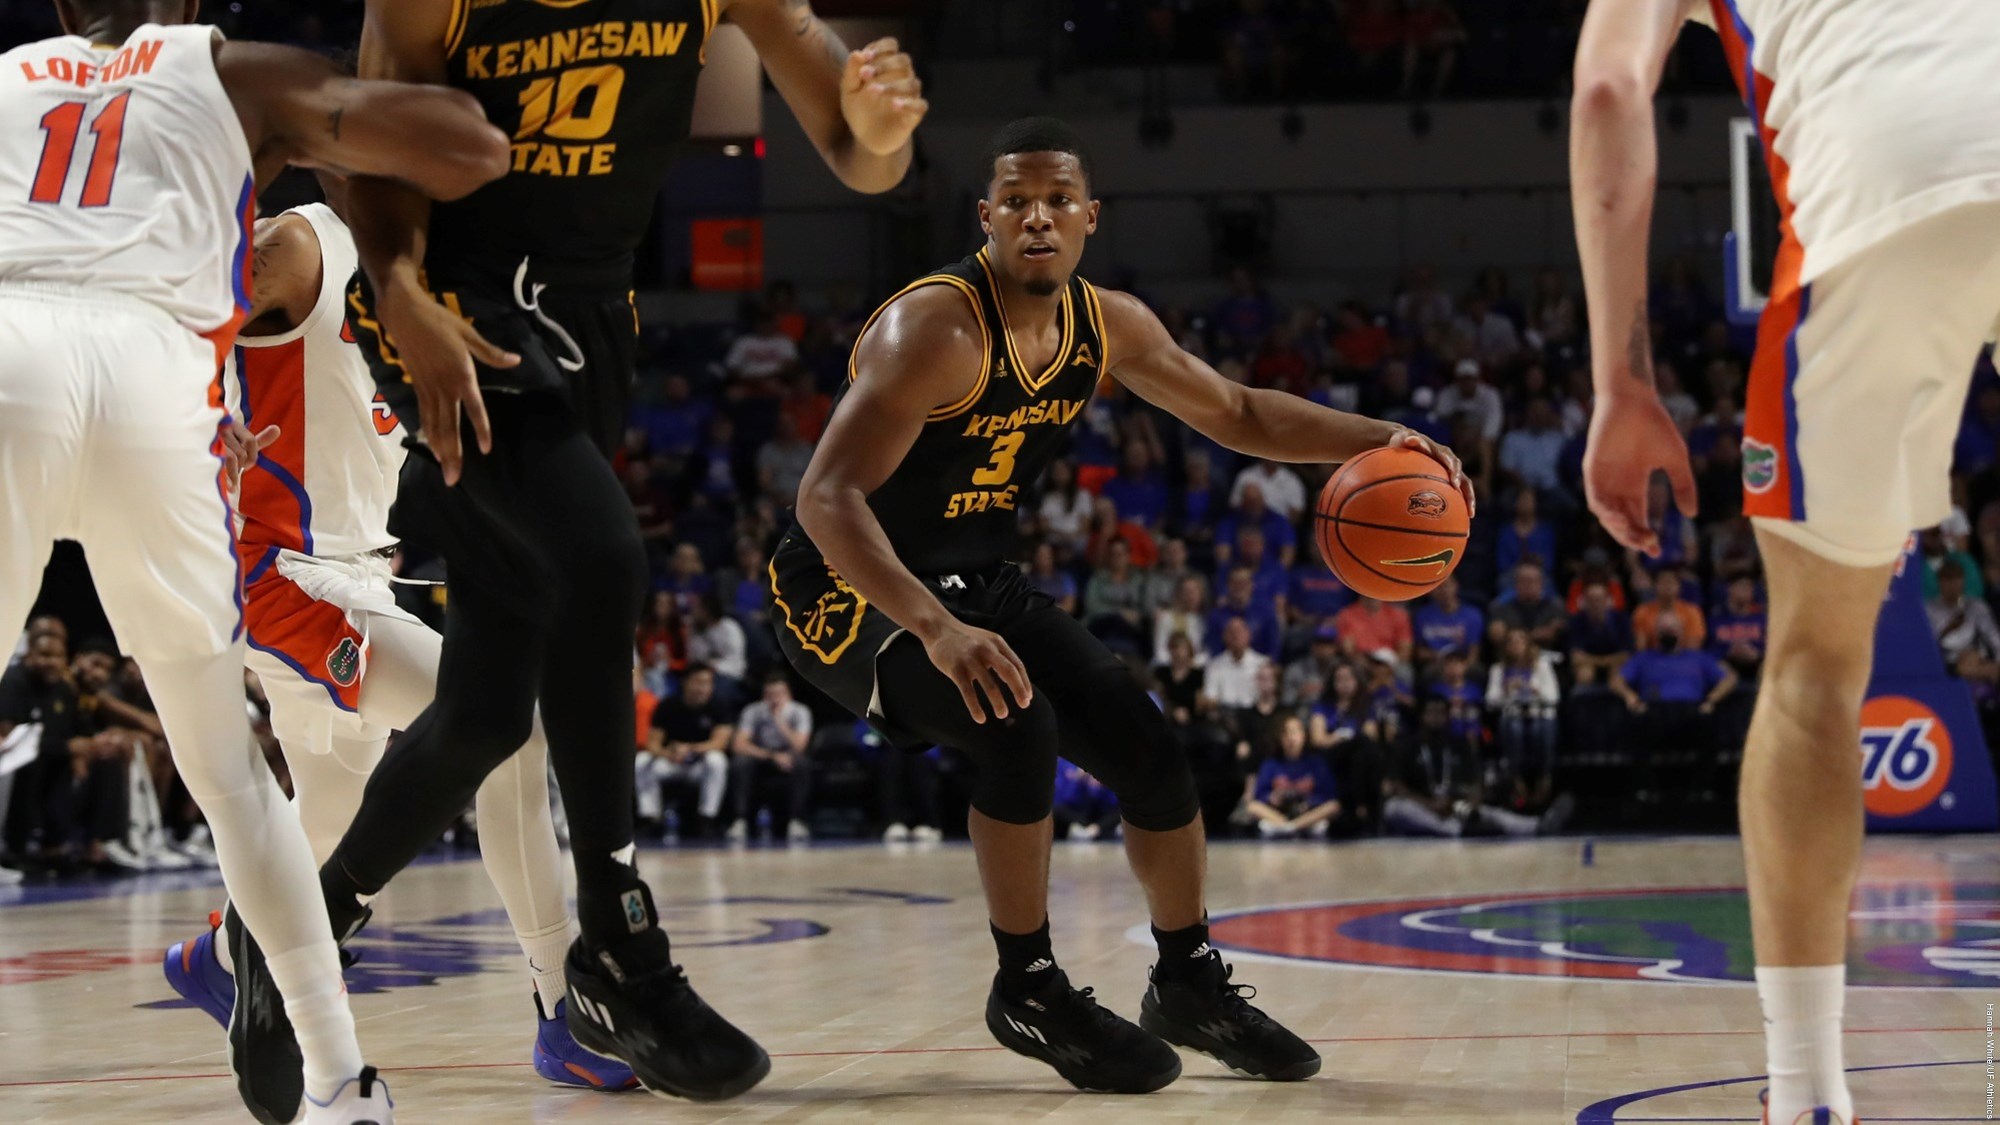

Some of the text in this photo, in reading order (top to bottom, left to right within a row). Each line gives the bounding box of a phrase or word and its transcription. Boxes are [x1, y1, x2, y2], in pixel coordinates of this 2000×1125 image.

[20, 39, 165, 89] LOFTON
[465, 20, 689, 81] KENNESAW
[513, 63, 626, 141] 10
[28, 88, 133, 209] 11
[510, 142, 617, 177] TATE
[961, 399, 1087, 439] KENSAW
[971, 430, 1026, 486] 3
[1860, 717, 1936, 791] 76
